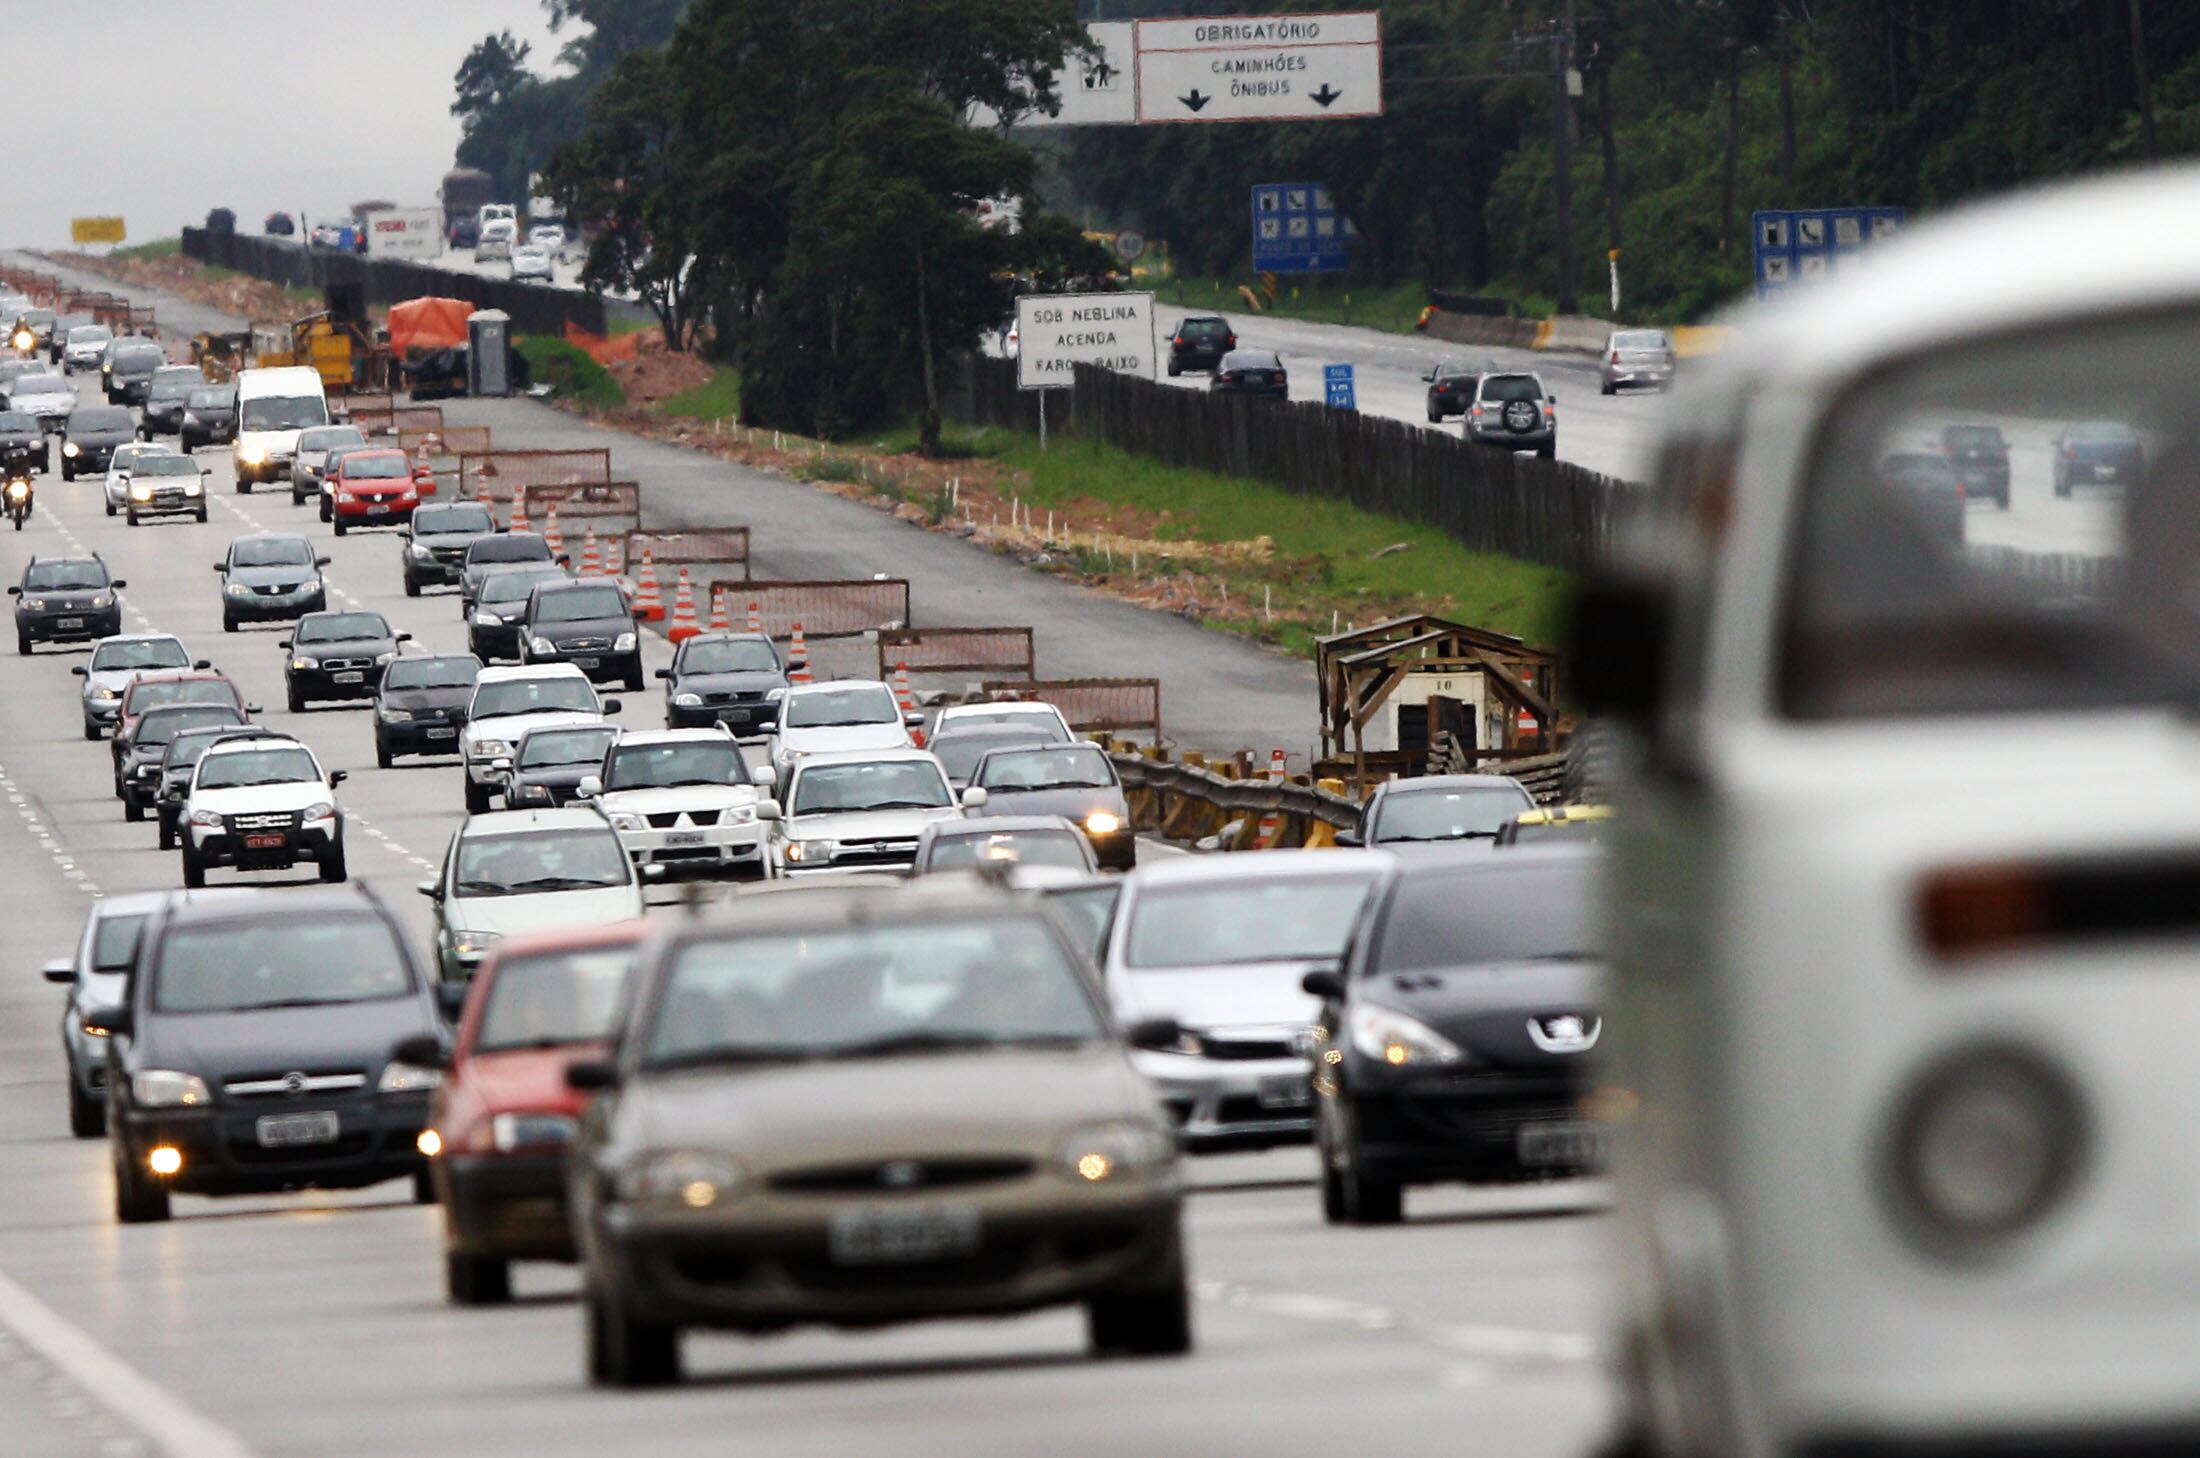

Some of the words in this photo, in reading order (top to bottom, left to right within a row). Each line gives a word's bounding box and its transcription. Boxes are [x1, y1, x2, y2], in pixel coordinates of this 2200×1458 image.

[1195, 18, 1320, 42] OBRIGATÓRIO
[1211, 53, 1307, 73] CAMINHÕES
[1231, 79, 1291, 97] ÔNIBUS
[1034, 309, 1063, 324] SOB
[1072, 306, 1137, 321] NEBLINA
[1056, 331, 1117, 346] ACENDA
[1436, 680, 1452, 691] 10
